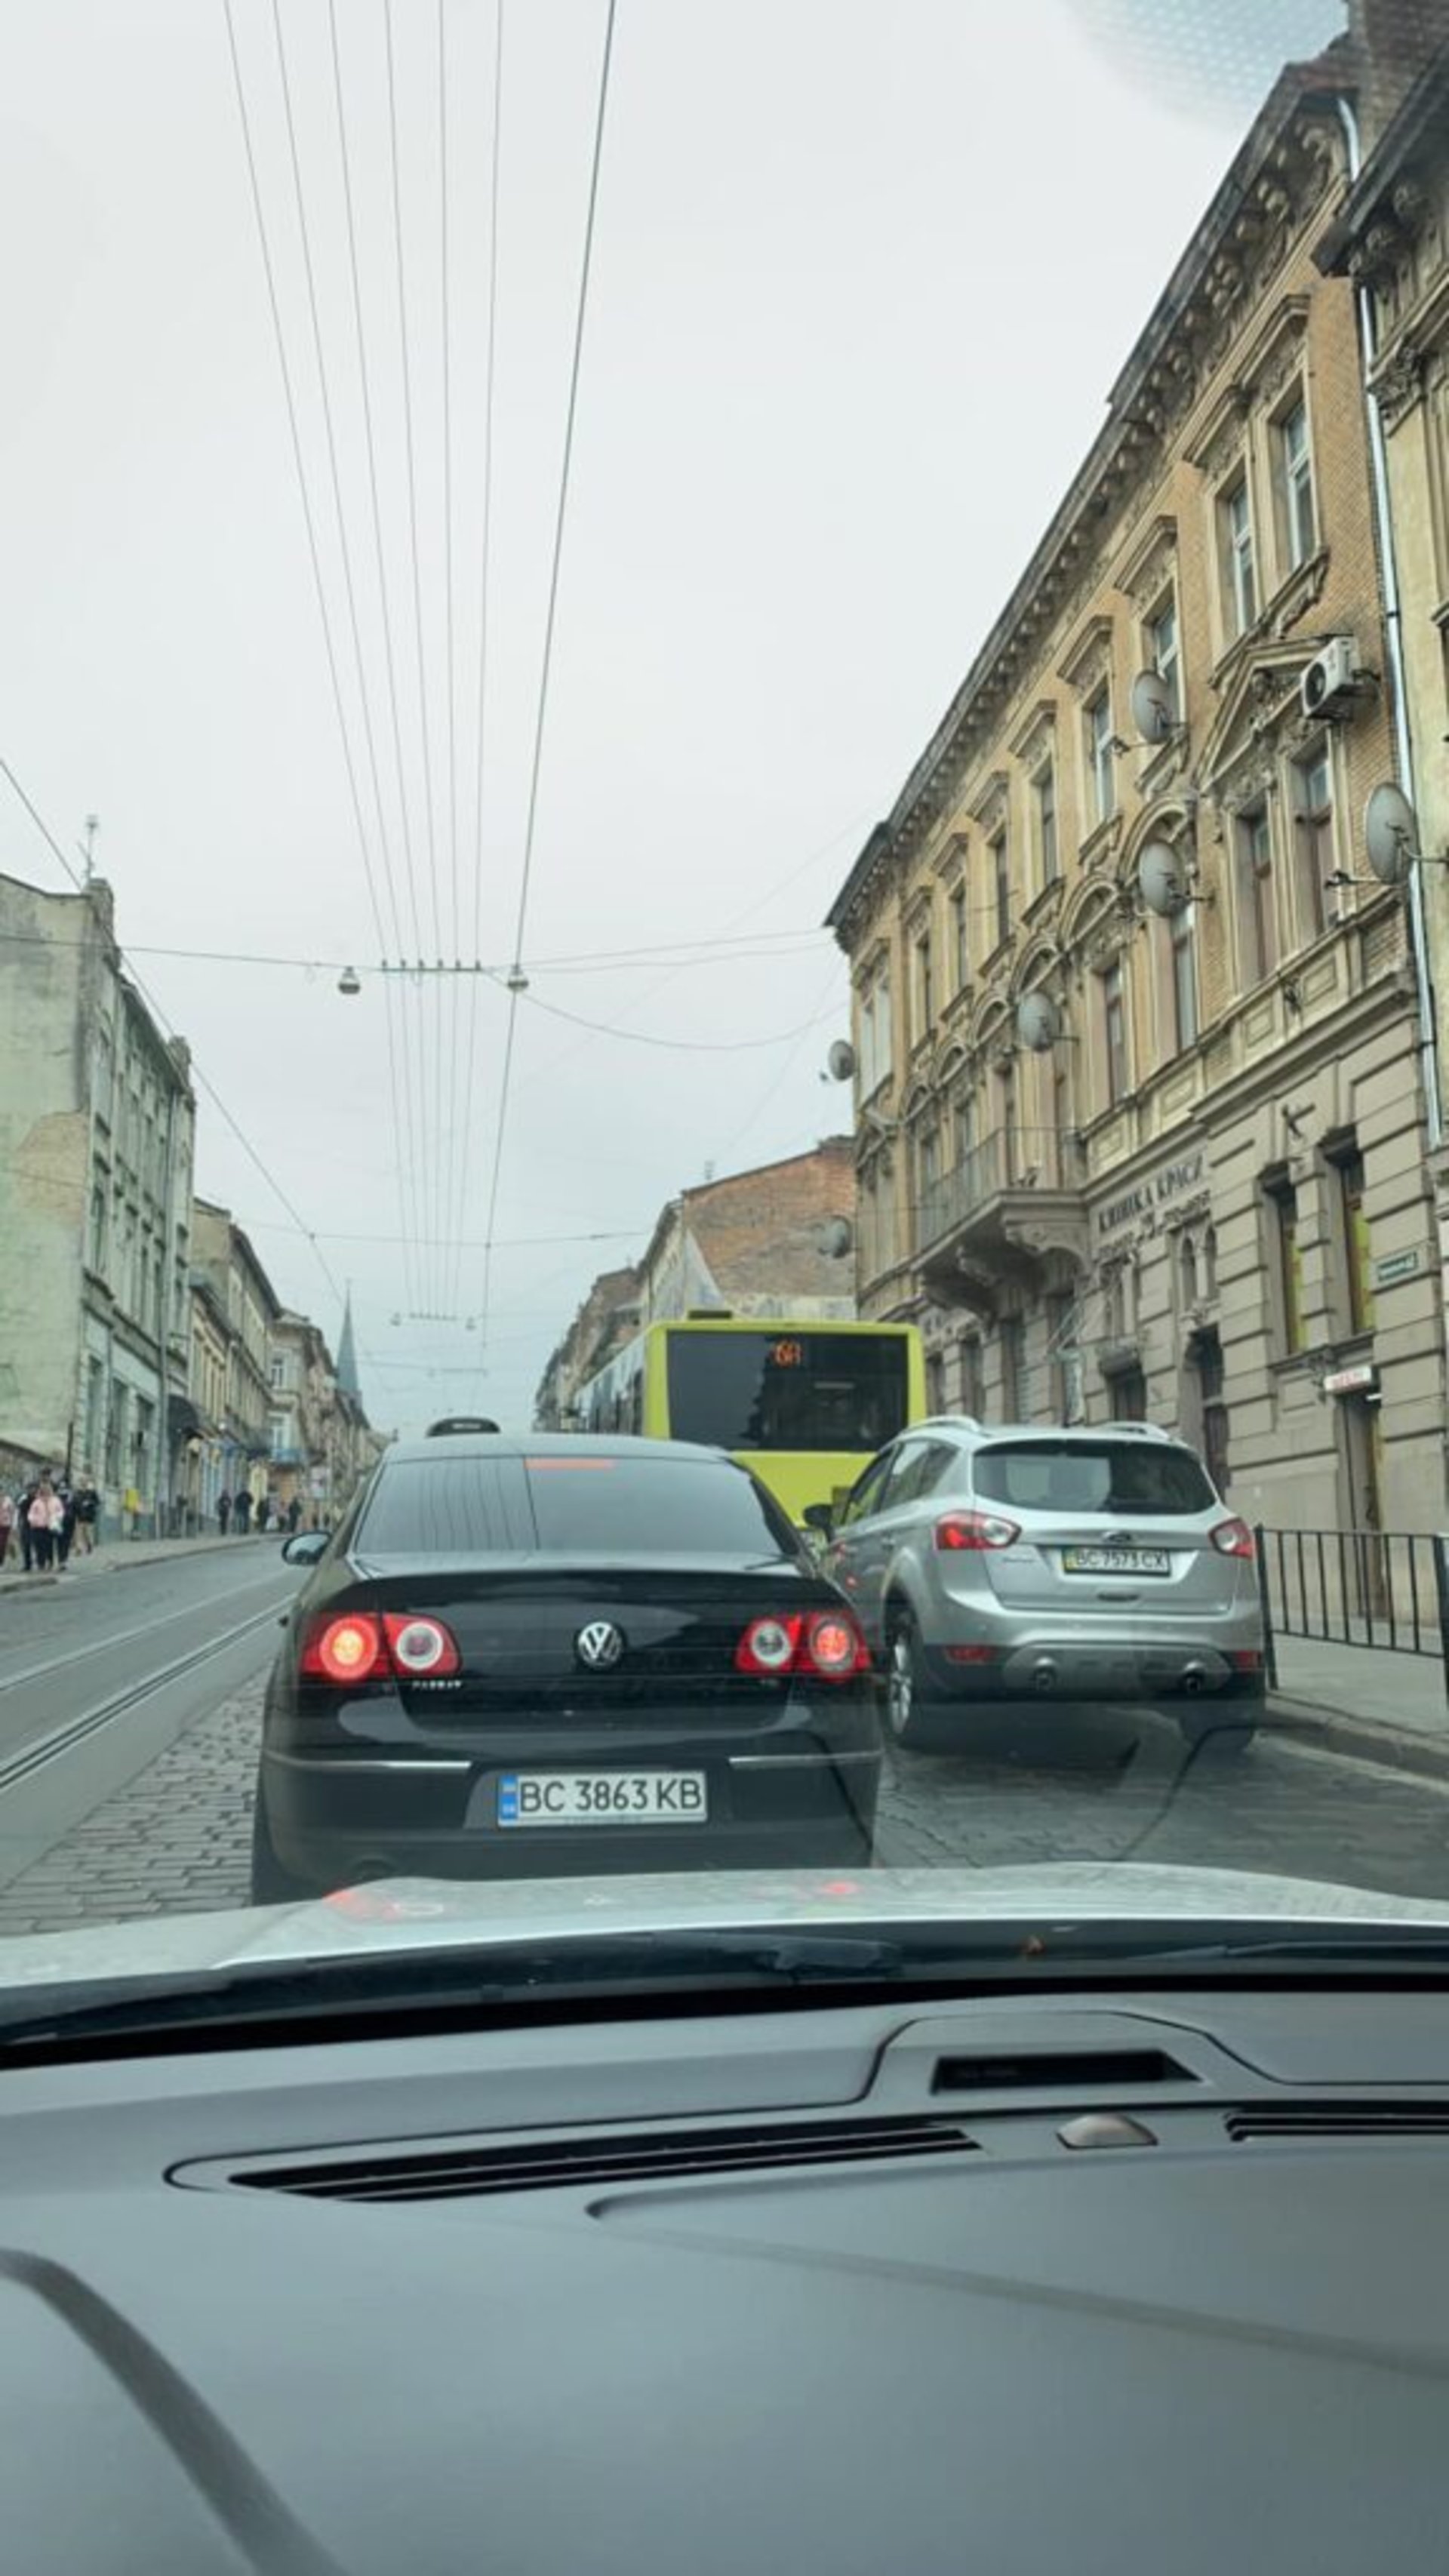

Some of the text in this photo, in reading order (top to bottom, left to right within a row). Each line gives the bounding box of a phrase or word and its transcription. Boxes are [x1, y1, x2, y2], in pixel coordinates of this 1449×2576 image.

[520, 1778, 702, 1812] BC 3863 KB
